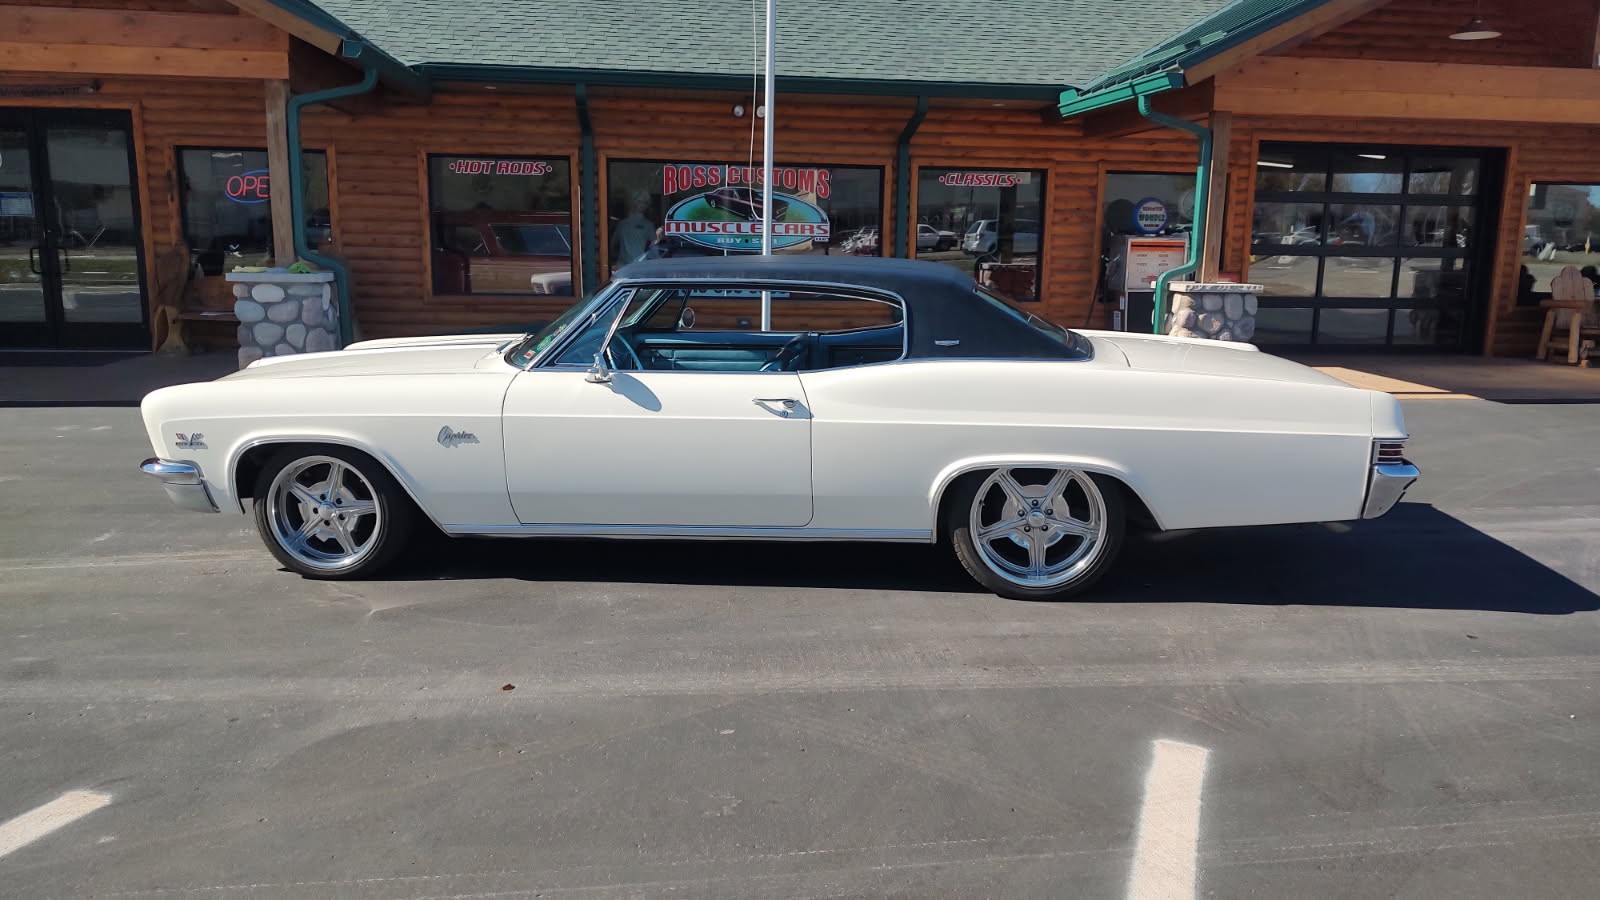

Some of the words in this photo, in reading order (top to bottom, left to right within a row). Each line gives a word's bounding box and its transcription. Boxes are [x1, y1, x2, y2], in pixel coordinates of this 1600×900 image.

[456, 160, 494, 174] HOT
[496, 161, 546, 175] RODS
[226, 175, 270, 198] OPE
[663, 164, 721, 196] ROSS
[727, 166, 830, 199] CUSTOMS
[945, 172, 1017, 187] CLASSICS
[665, 221, 763, 235] MUSCLE
[770, 222, 830, 235] CARS
